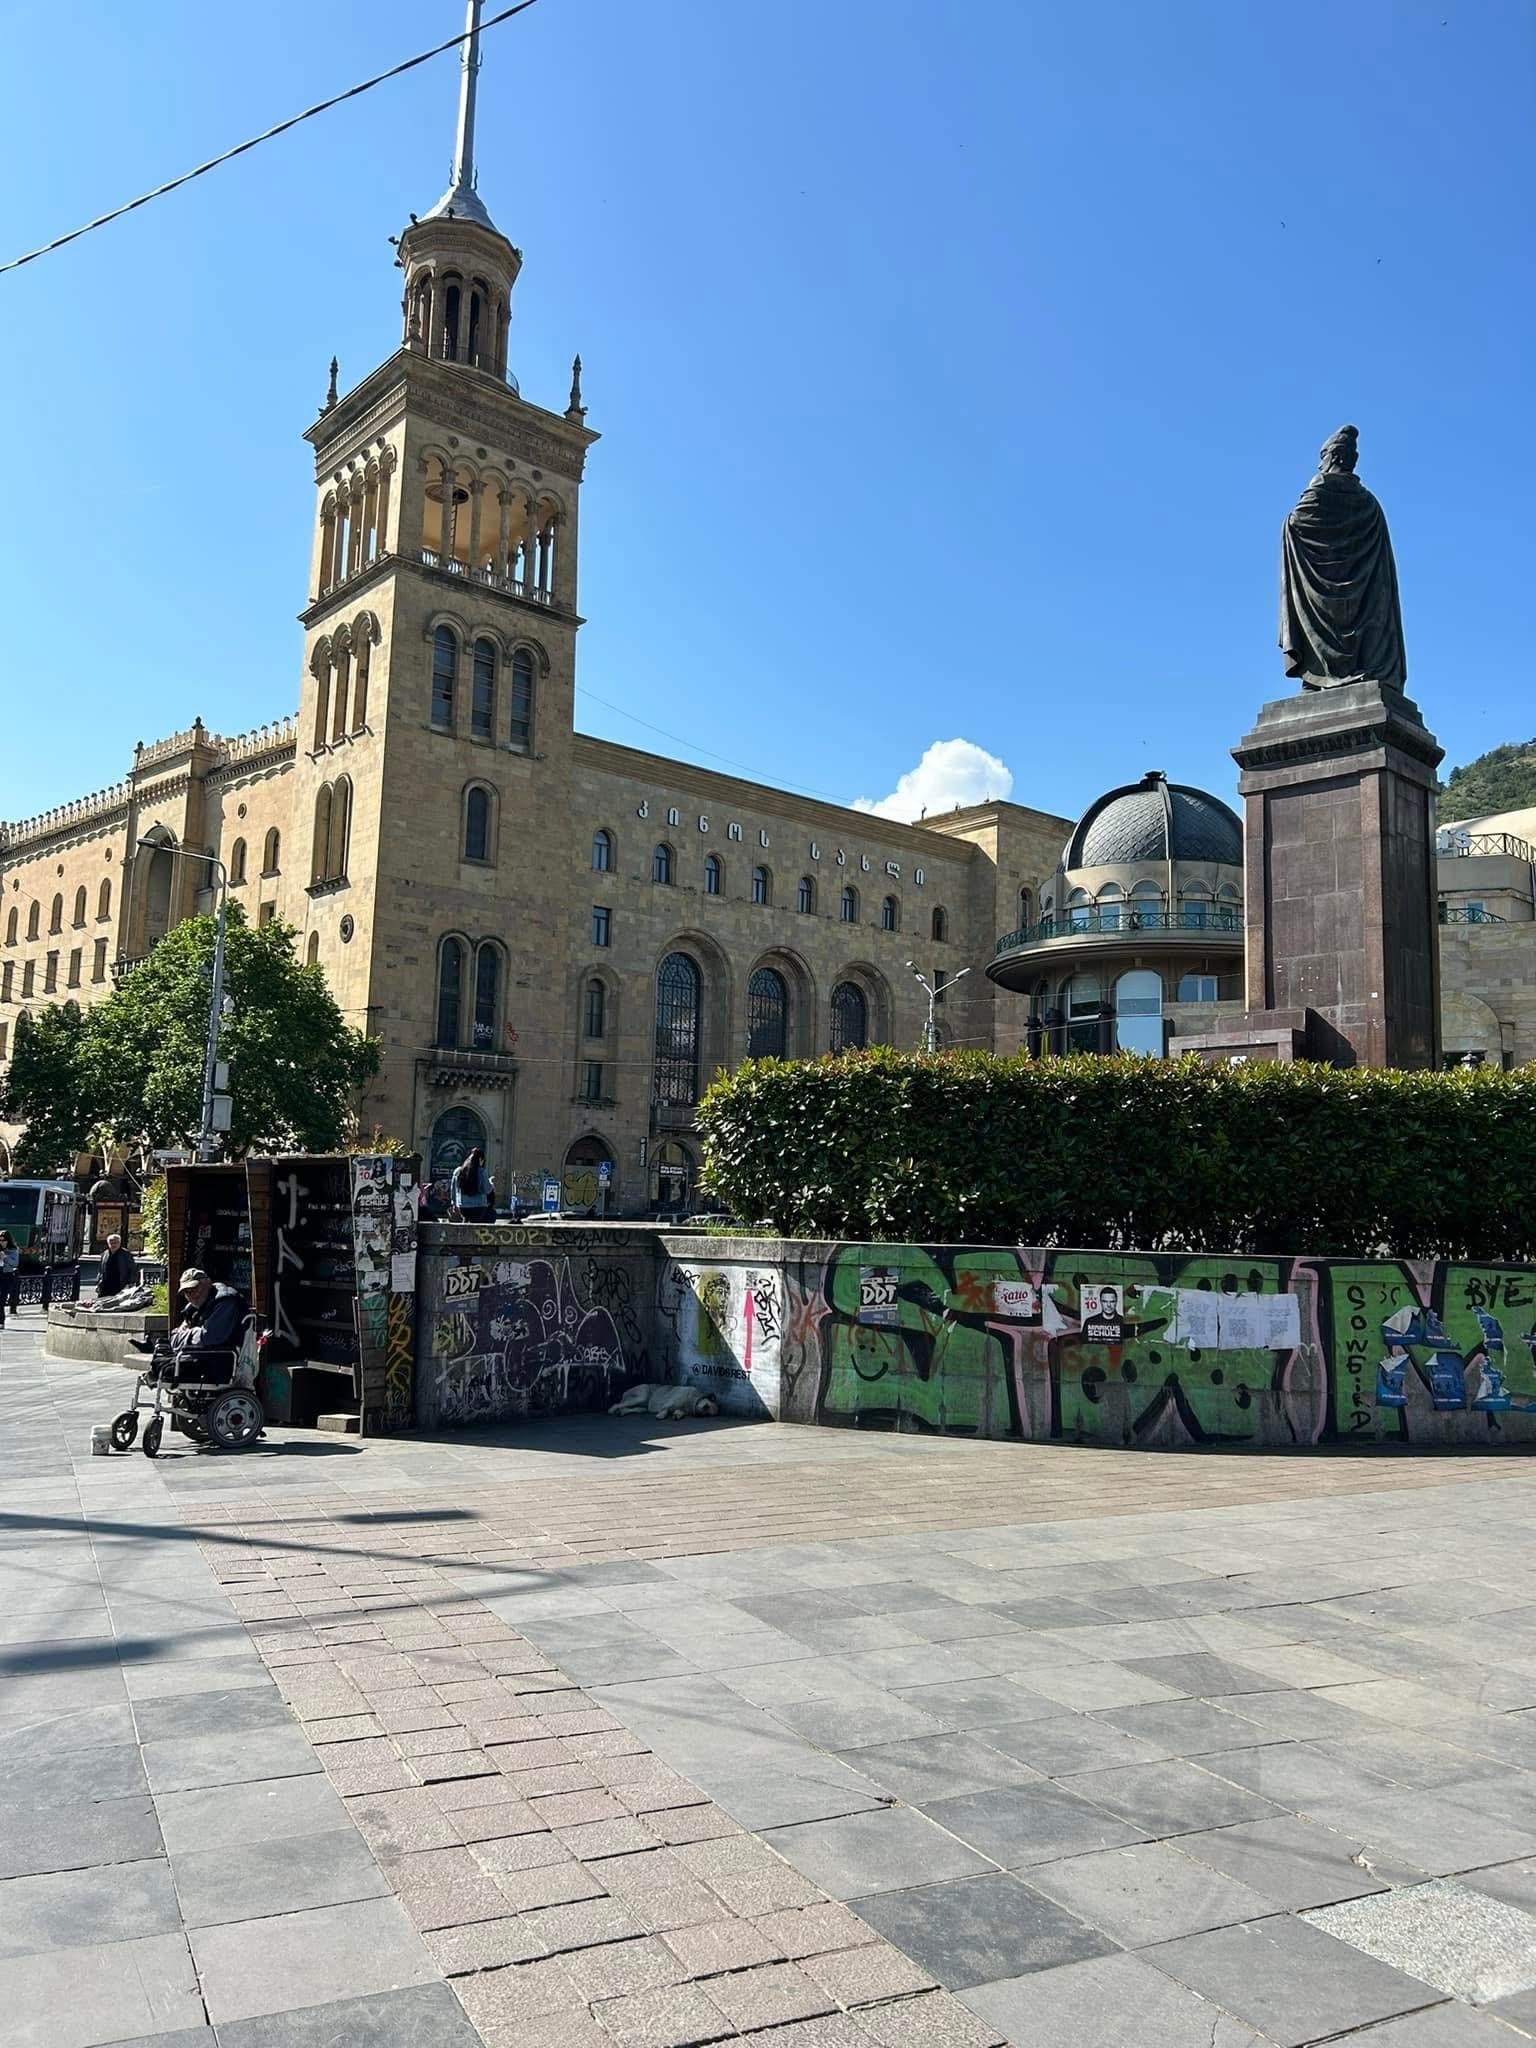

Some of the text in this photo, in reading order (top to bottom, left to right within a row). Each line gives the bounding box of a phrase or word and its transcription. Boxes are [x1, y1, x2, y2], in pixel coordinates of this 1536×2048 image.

[637, 800, 925, 886] კინოს სახლი
[448, 1270, 481, 1295] DDT
[862, 1281, 897, 1305] DDT
[1464, 1275, 1533, 1310] BYE
[1085, 1301, 1097, 1310] 10
